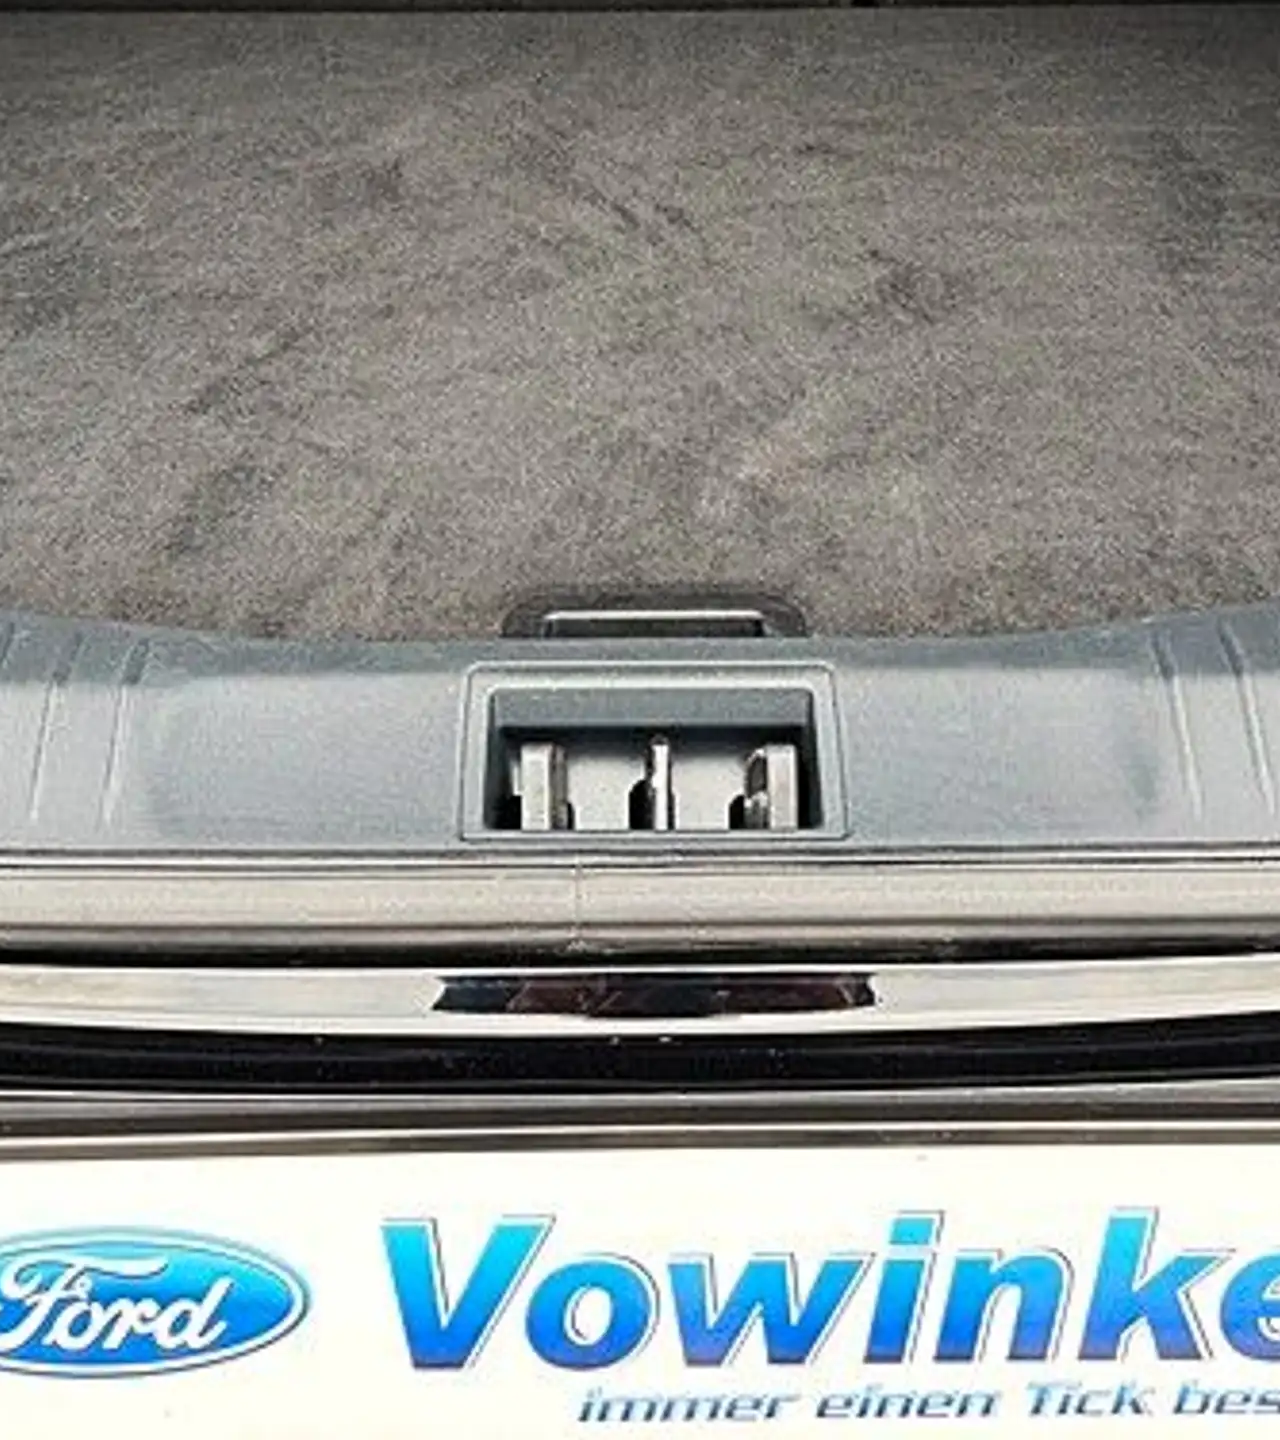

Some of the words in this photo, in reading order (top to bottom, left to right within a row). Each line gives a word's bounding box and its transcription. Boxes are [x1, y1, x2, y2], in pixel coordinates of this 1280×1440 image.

[578, 1387, 800, 1423] immer
[816, 1384, 1003, 1420] einen
[1026, 1380, 1154, 1418] Tick
